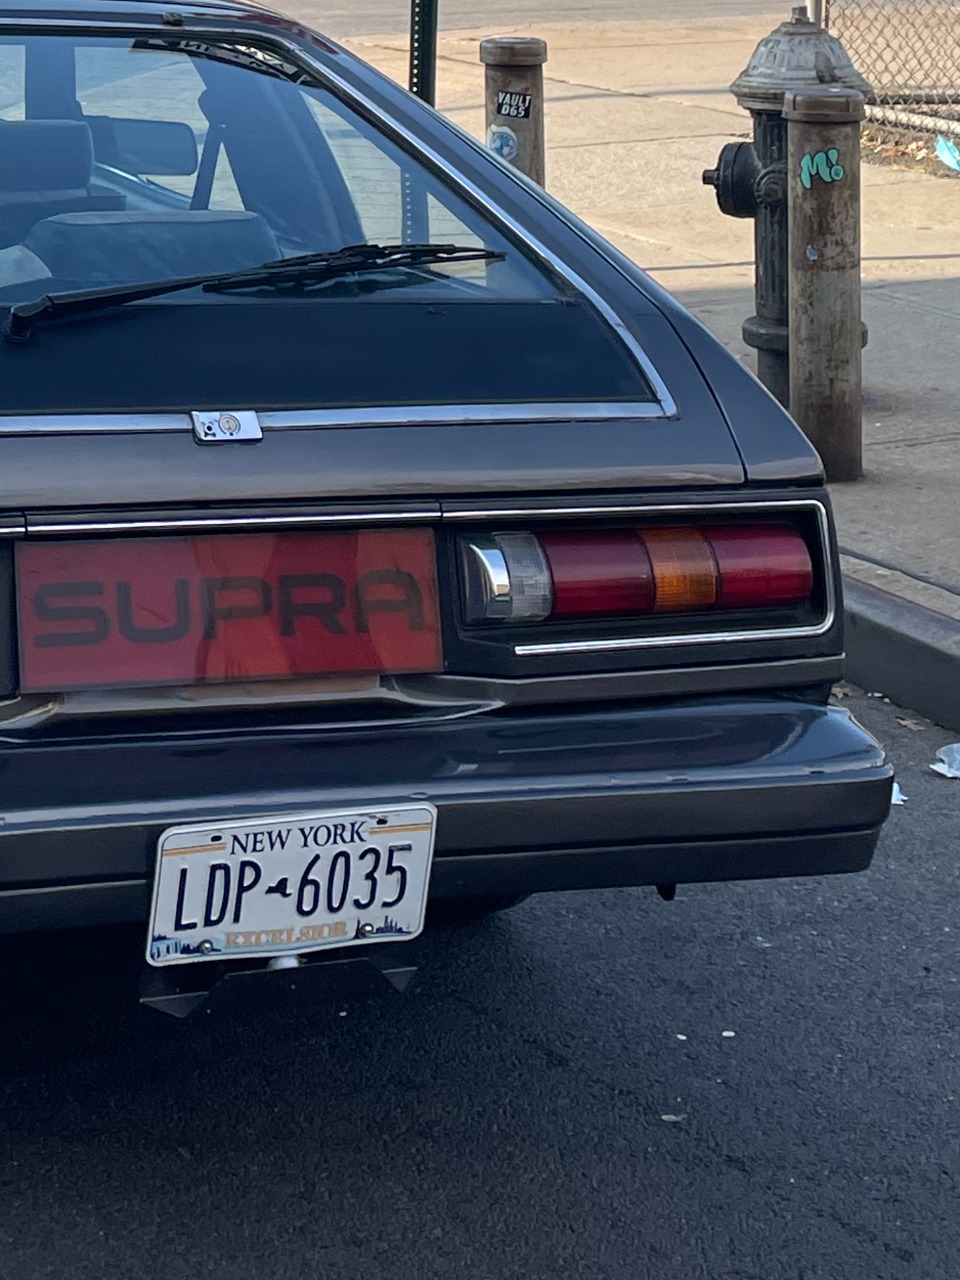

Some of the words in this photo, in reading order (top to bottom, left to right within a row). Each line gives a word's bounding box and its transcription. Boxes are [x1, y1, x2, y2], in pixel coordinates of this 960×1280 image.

[498, 91, 531, 108] VAULT
[33, 569, 426, 648] SUPRA
[230, 828, 292, 855] NEW
[298, 821, 367, 848] YORK
[174, 860, 262, 931] LDP
[296, 844, 412, 917] 6035
[225, 921, 348, 949] EXCELSIOR
